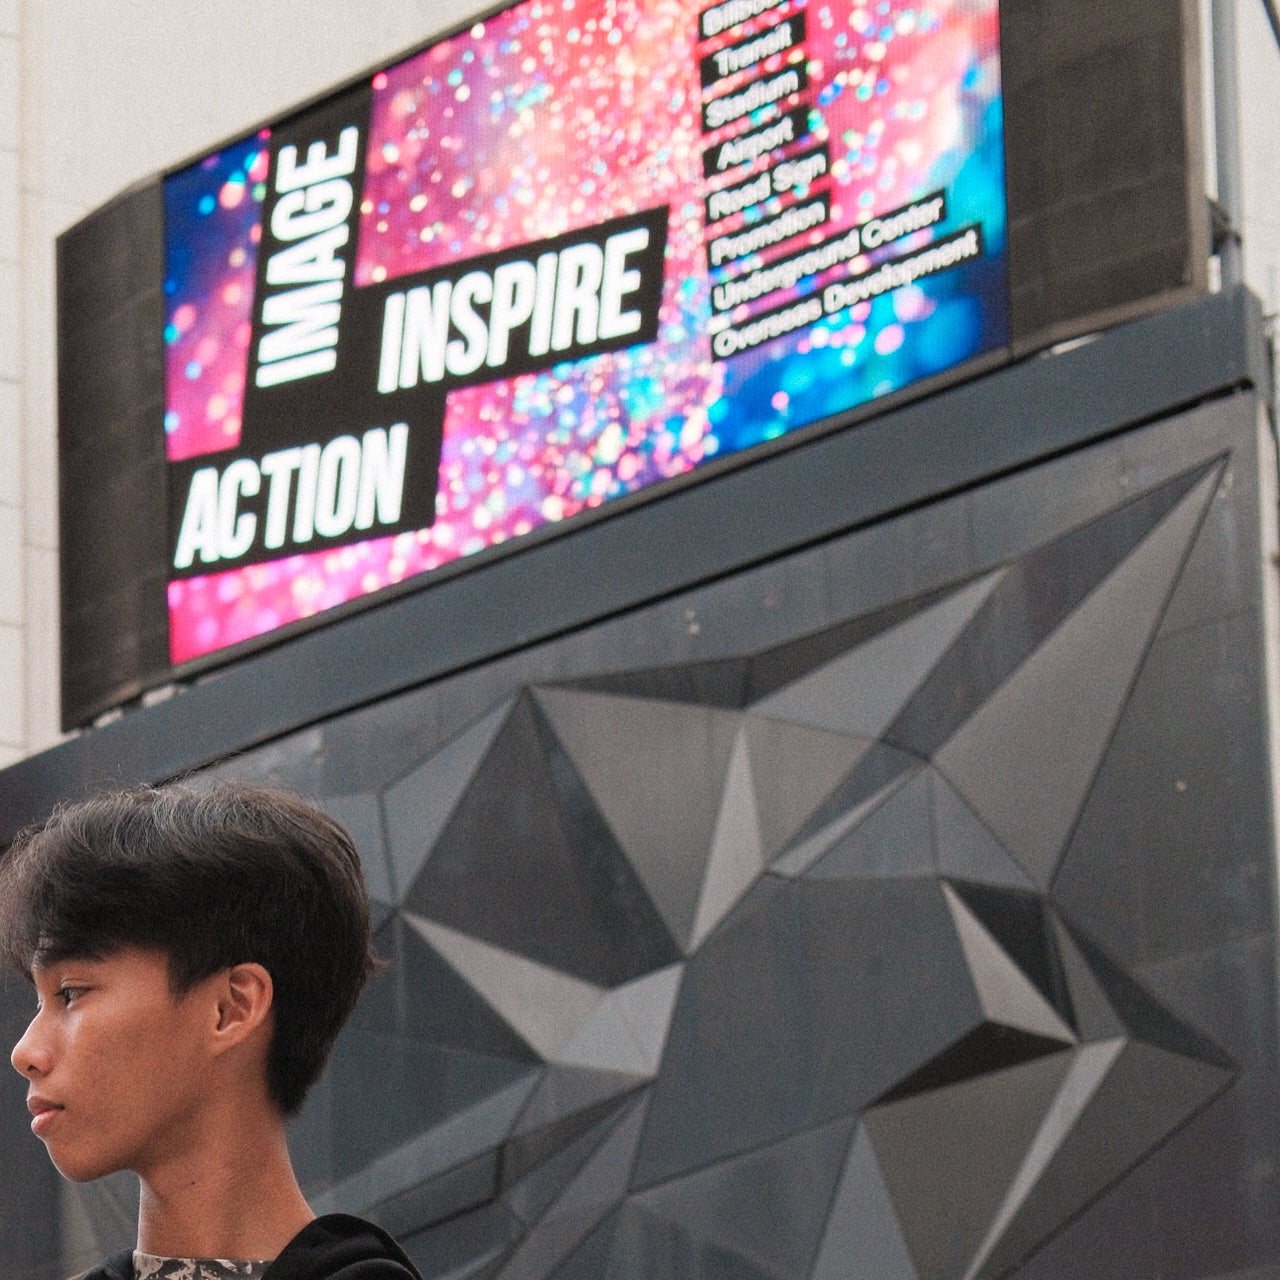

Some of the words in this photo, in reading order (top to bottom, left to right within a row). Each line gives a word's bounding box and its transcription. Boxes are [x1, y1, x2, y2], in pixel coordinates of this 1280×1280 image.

[705, 70, 799, 128] Stadium
[716, 116, 794, 171] Airport
[708, 172, 771, 221] Road
[772, 152, 827, 193] Sign
[710, 201, 826, 267] Promotion
[256, 127, 359, 389] IMAGE
[378, 227, 650, 395] INSPIRE
[713, 228, 861, 311] Underground
[861, 197, 944, 250] Center
[713, 298, 823, 358] Overseas
[823, 229, 979, 314] Development
[175, 422, 410, 570] ACTION
